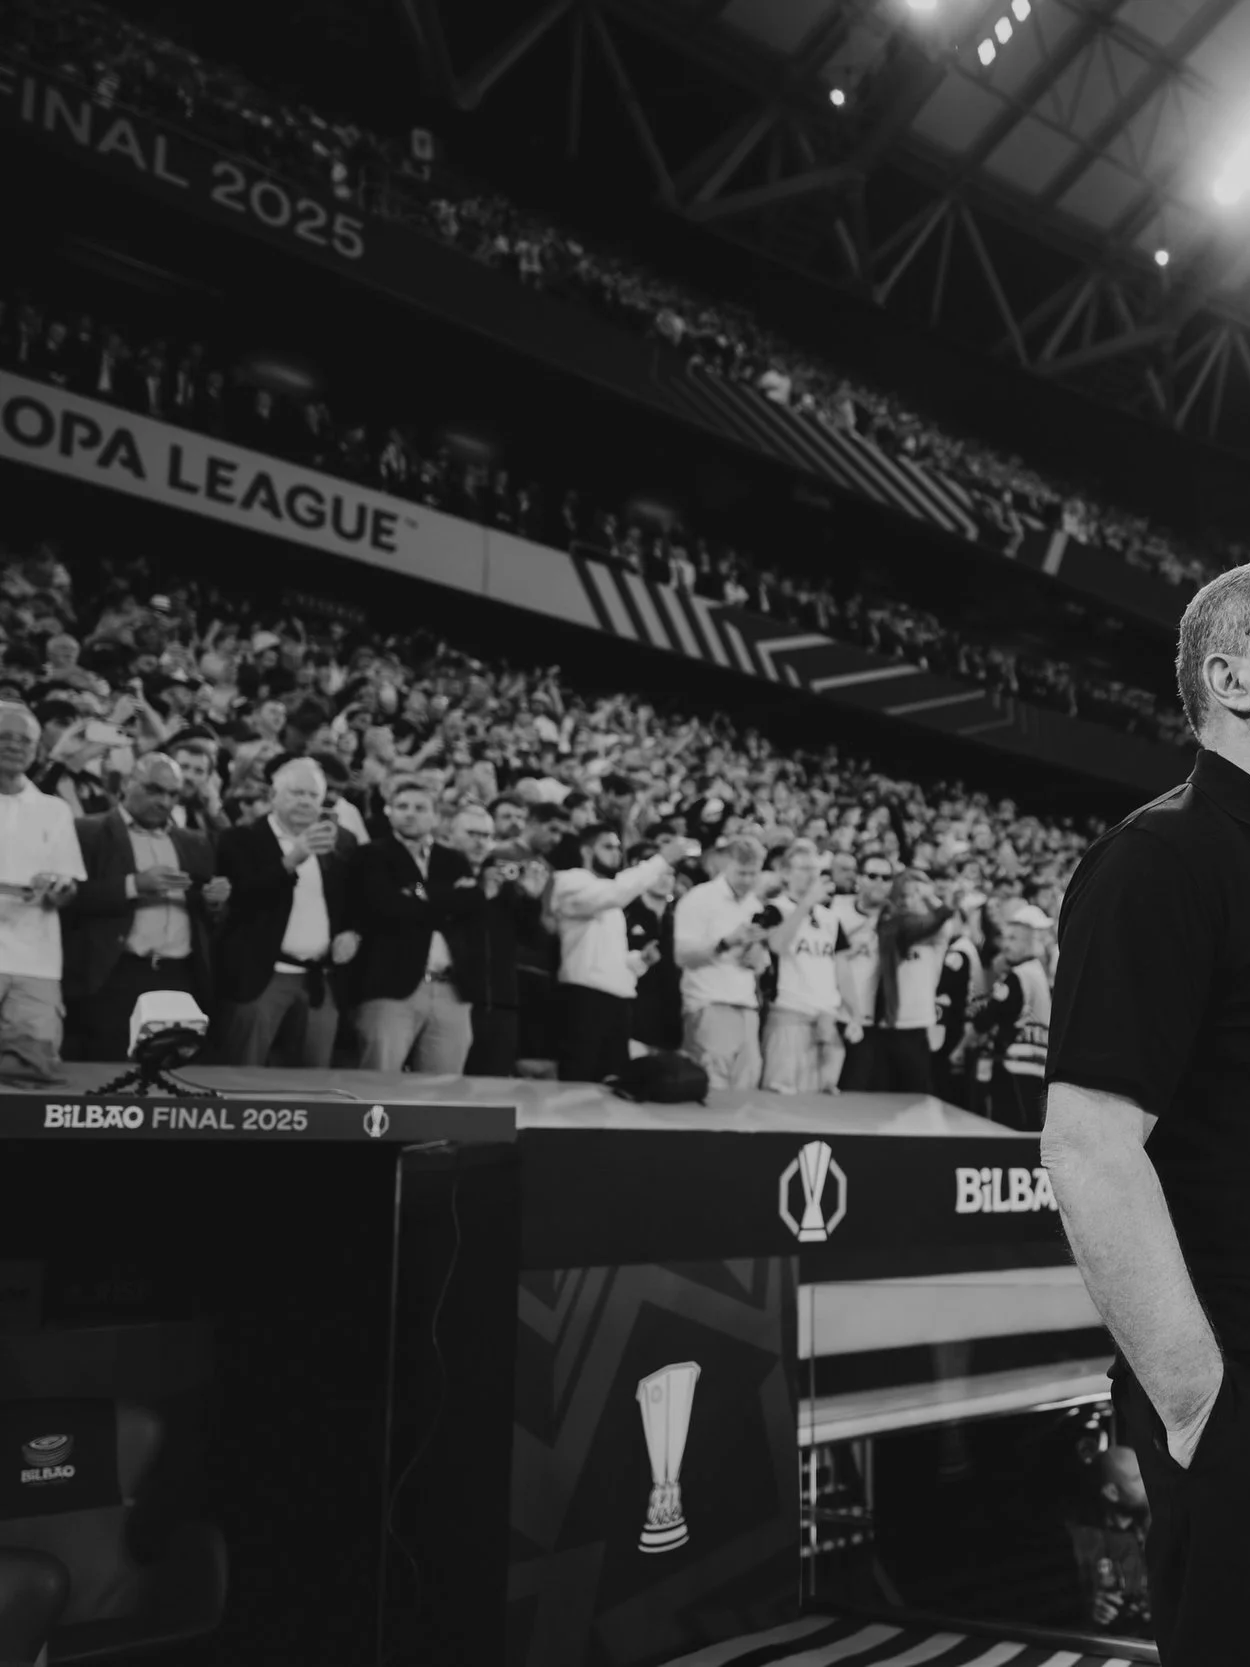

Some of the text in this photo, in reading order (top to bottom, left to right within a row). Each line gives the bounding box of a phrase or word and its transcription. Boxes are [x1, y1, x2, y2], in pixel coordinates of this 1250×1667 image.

[209, 160, 366, 261] 2025
[3, 394, 399, 553] OPA LEAGUE
[152, 1107, 236, 1130] FINAL
[242, 1108, 309, 1131] 2025
